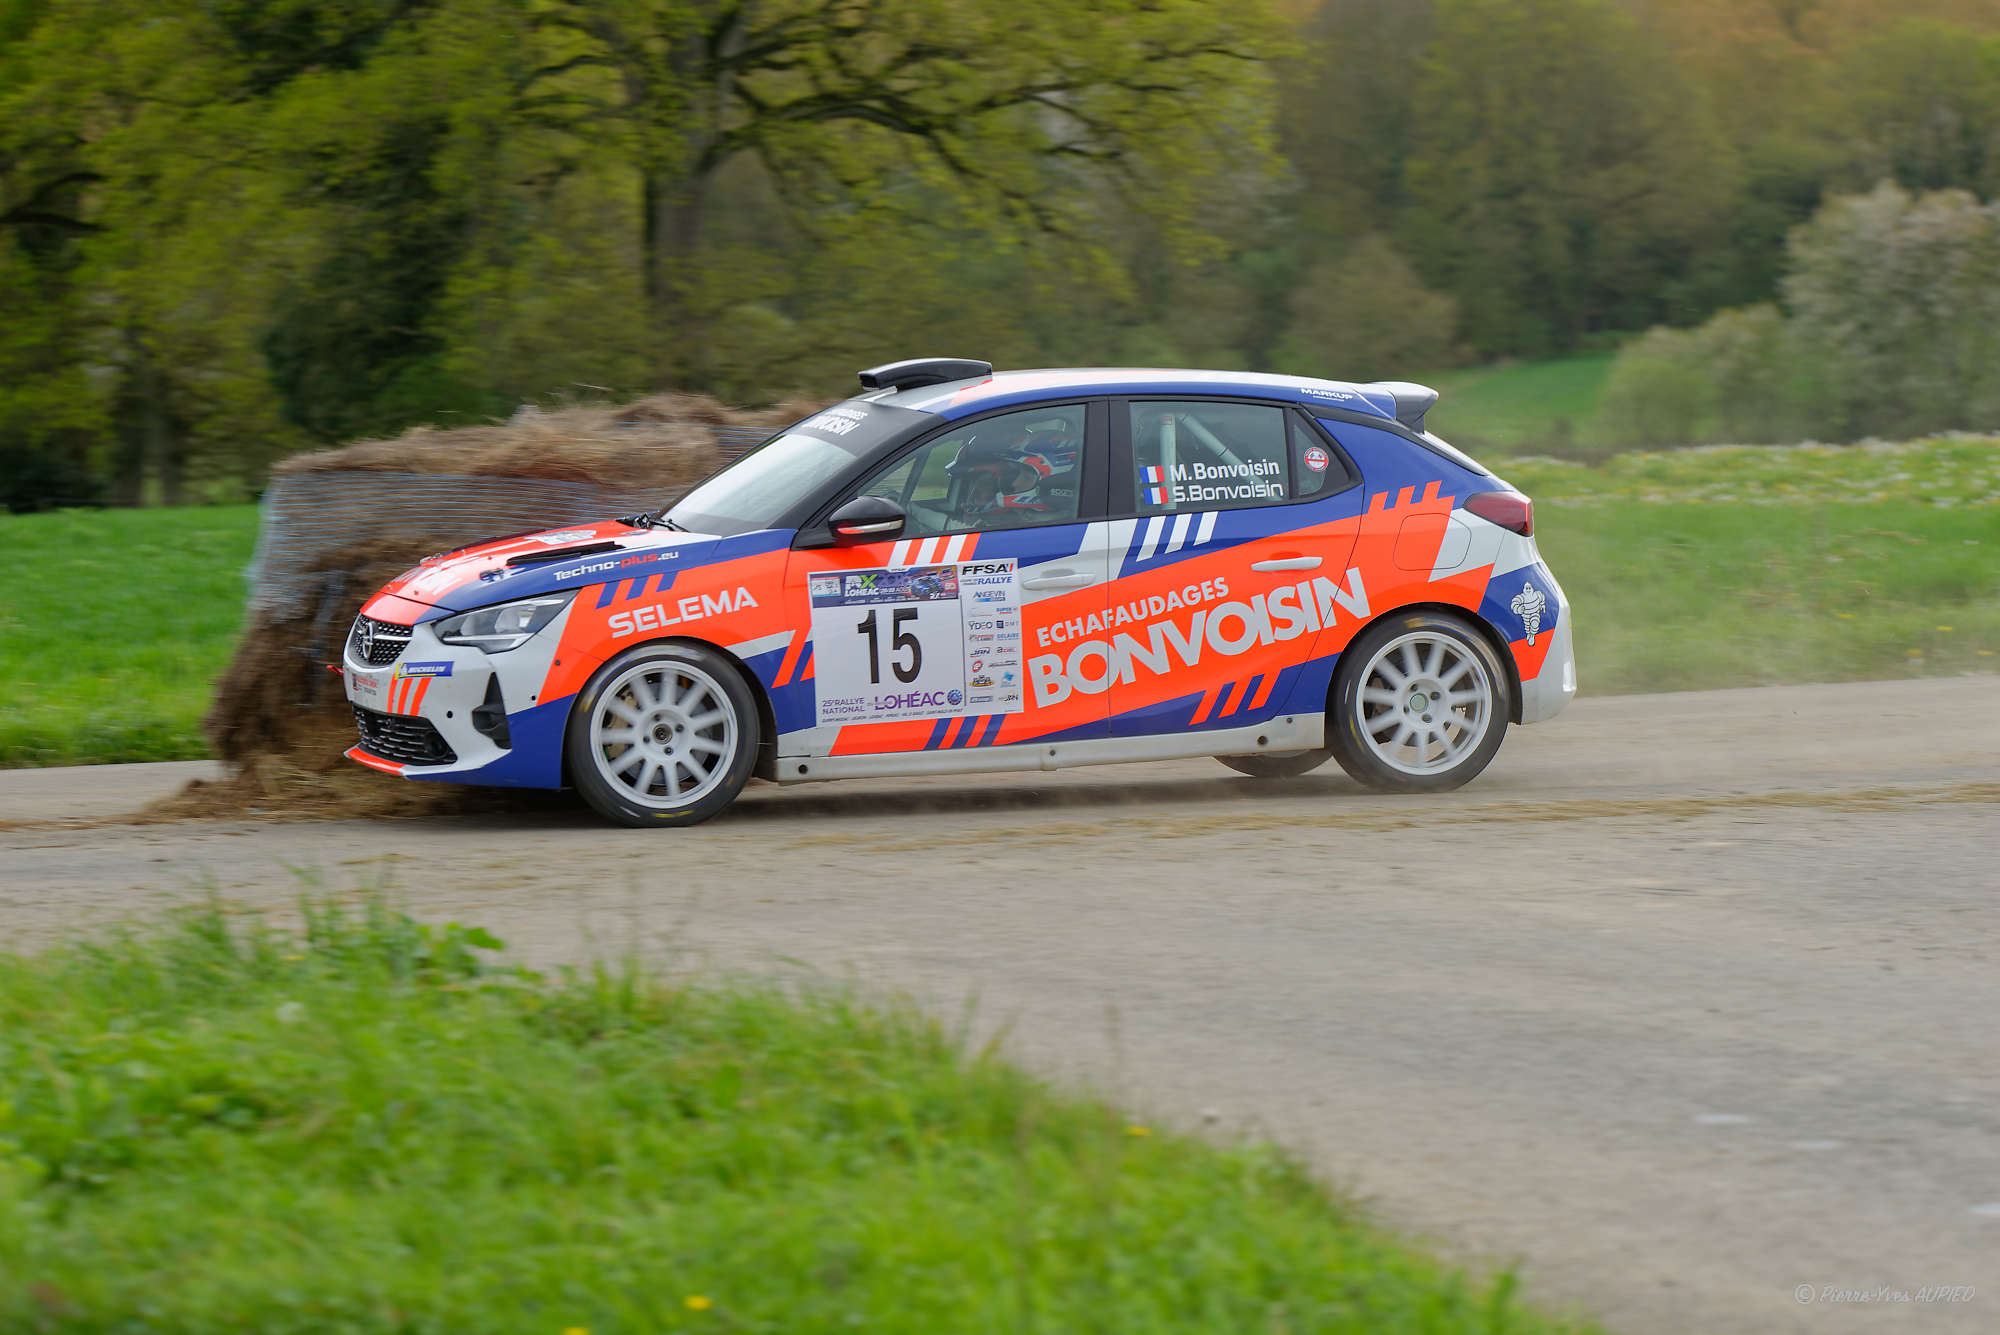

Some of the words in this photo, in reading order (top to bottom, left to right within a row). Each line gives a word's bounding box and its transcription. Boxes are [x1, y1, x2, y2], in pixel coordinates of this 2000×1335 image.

[1301, 388, 1353, 399] MARKUP
[1169, 463, 1193, 482] M.
[1193, 459, 1280, 480] Bonvoisin
[553, 551, 680, 581] Techno-plus.eu
[962, 563, 1010, 575] FFSA
[977, 576, 1013, 585] RALLYE
[608, 586, 759, 638] SELEMA
[1036, 577, 1230, 647] ECHAFAUDAGES
[857, 607, 922, 684] 15
[1027, 567, 1371, 708] BONVOISIN
[822, 705, 865, 715] NATIONAL
[874, 690, 945, 711] LOHÉAC
